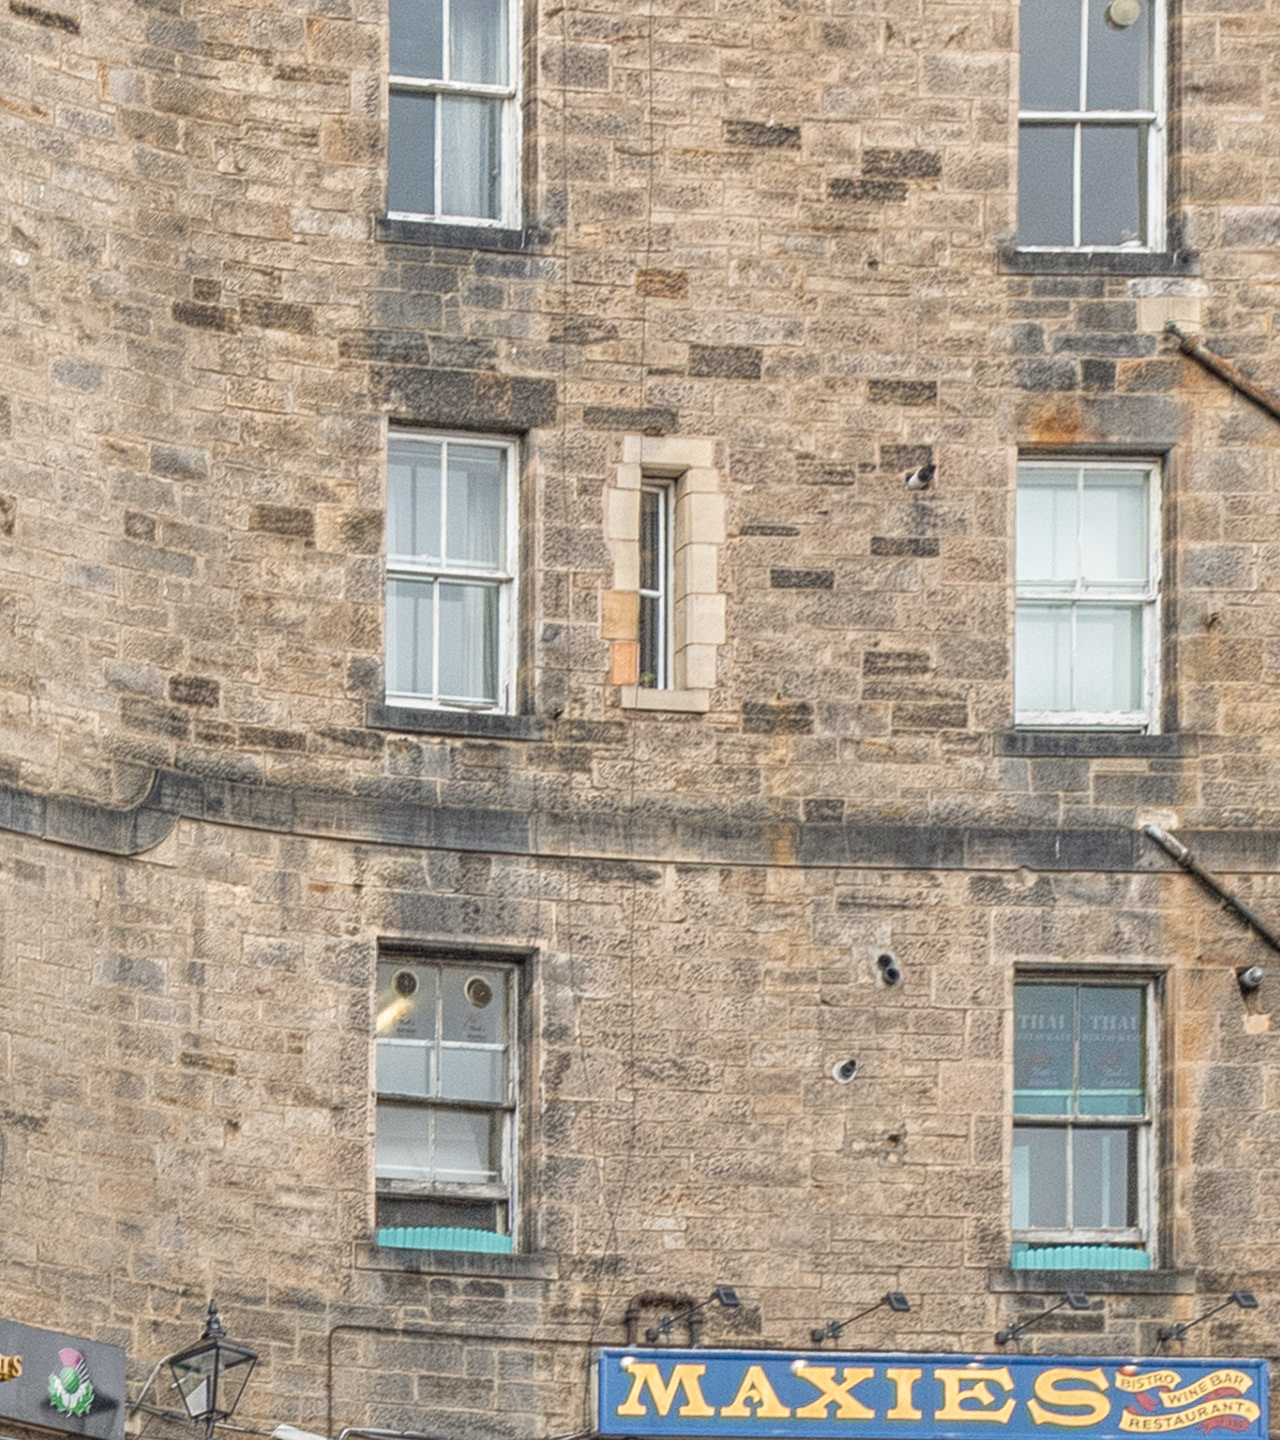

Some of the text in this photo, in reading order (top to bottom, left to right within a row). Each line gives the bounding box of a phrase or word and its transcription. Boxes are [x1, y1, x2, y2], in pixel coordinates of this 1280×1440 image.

[616, 1362, 1112, 1427] MAXIES
[1120, 1372, 1175, 1390] BISTRO
[1167, 1372, 1245, 1406] WINE BAR
[1128, 1400, 1243, 1430] RESTAURANT
